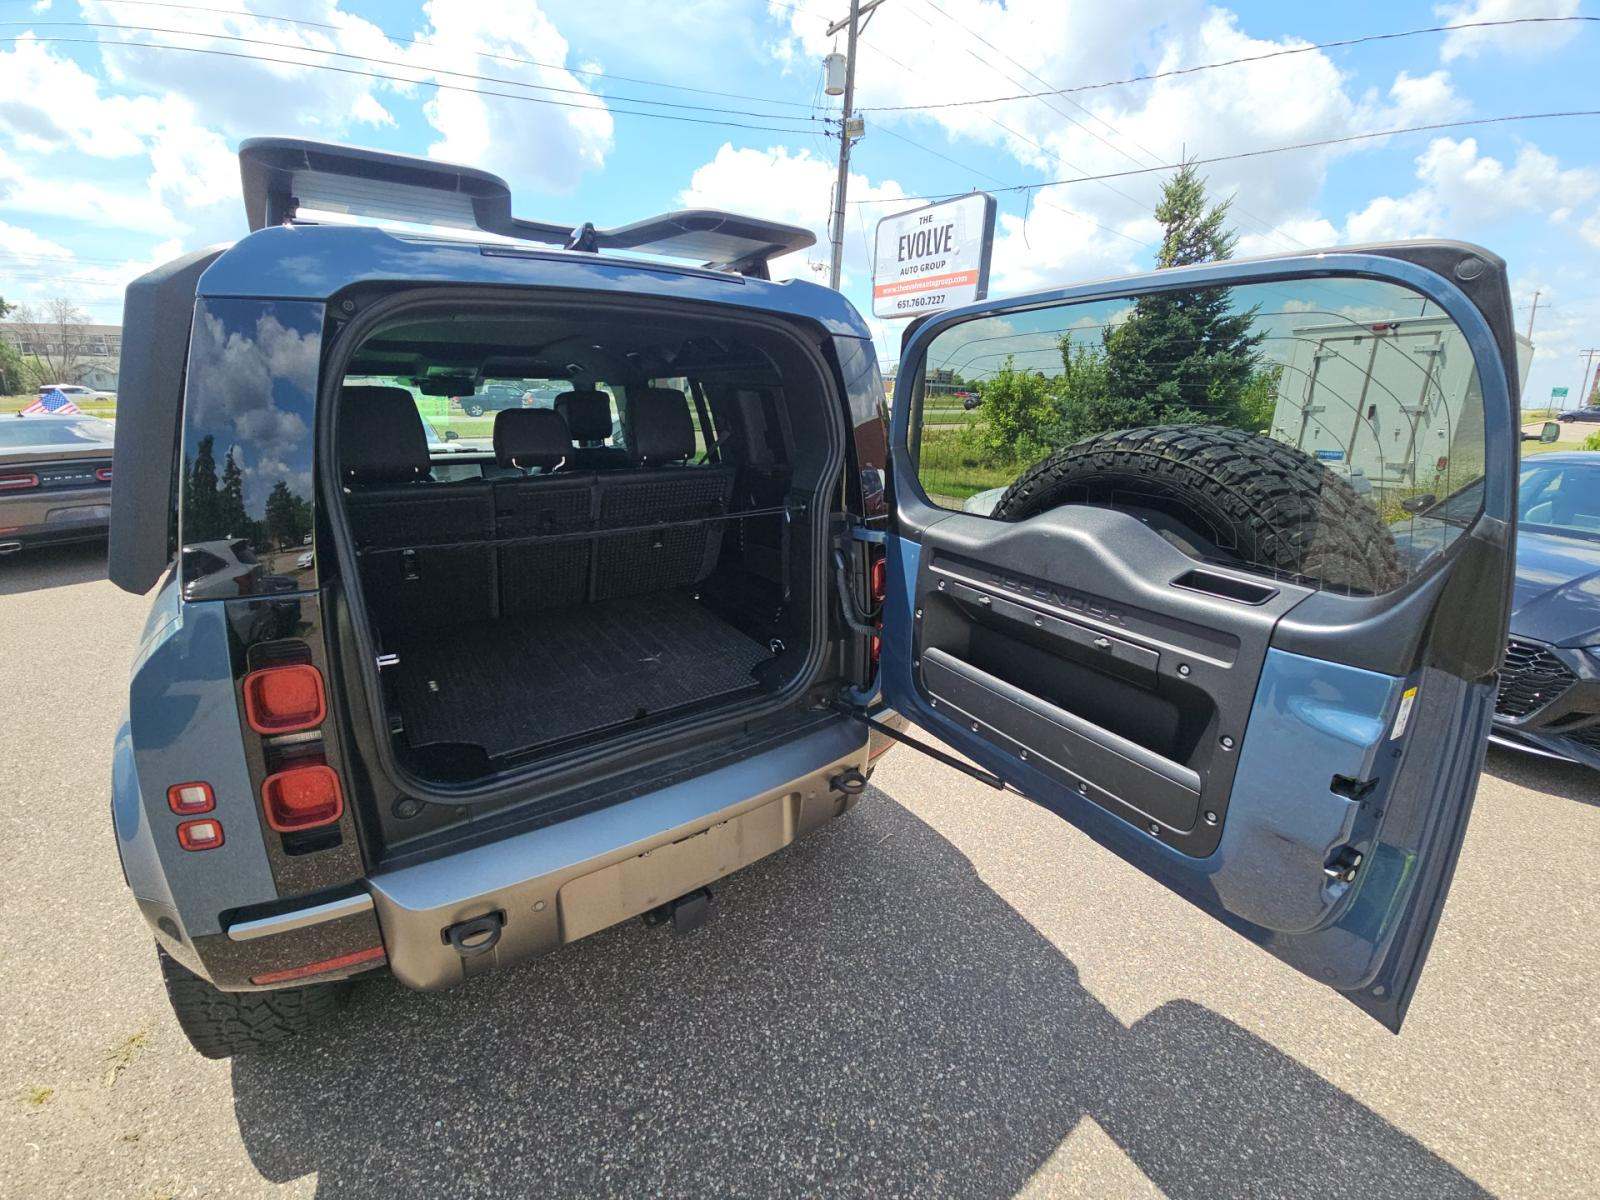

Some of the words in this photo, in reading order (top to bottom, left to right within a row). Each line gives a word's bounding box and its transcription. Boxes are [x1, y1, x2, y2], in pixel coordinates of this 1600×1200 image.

[919, 214, 934, 225] THE
[898, 224, 954, 262] EVOLVE
[900, 265, 919, 277] AUTO
[920, 260, 946, 273] GROUP
[897, 295, 946, 309] 651.760.7227
